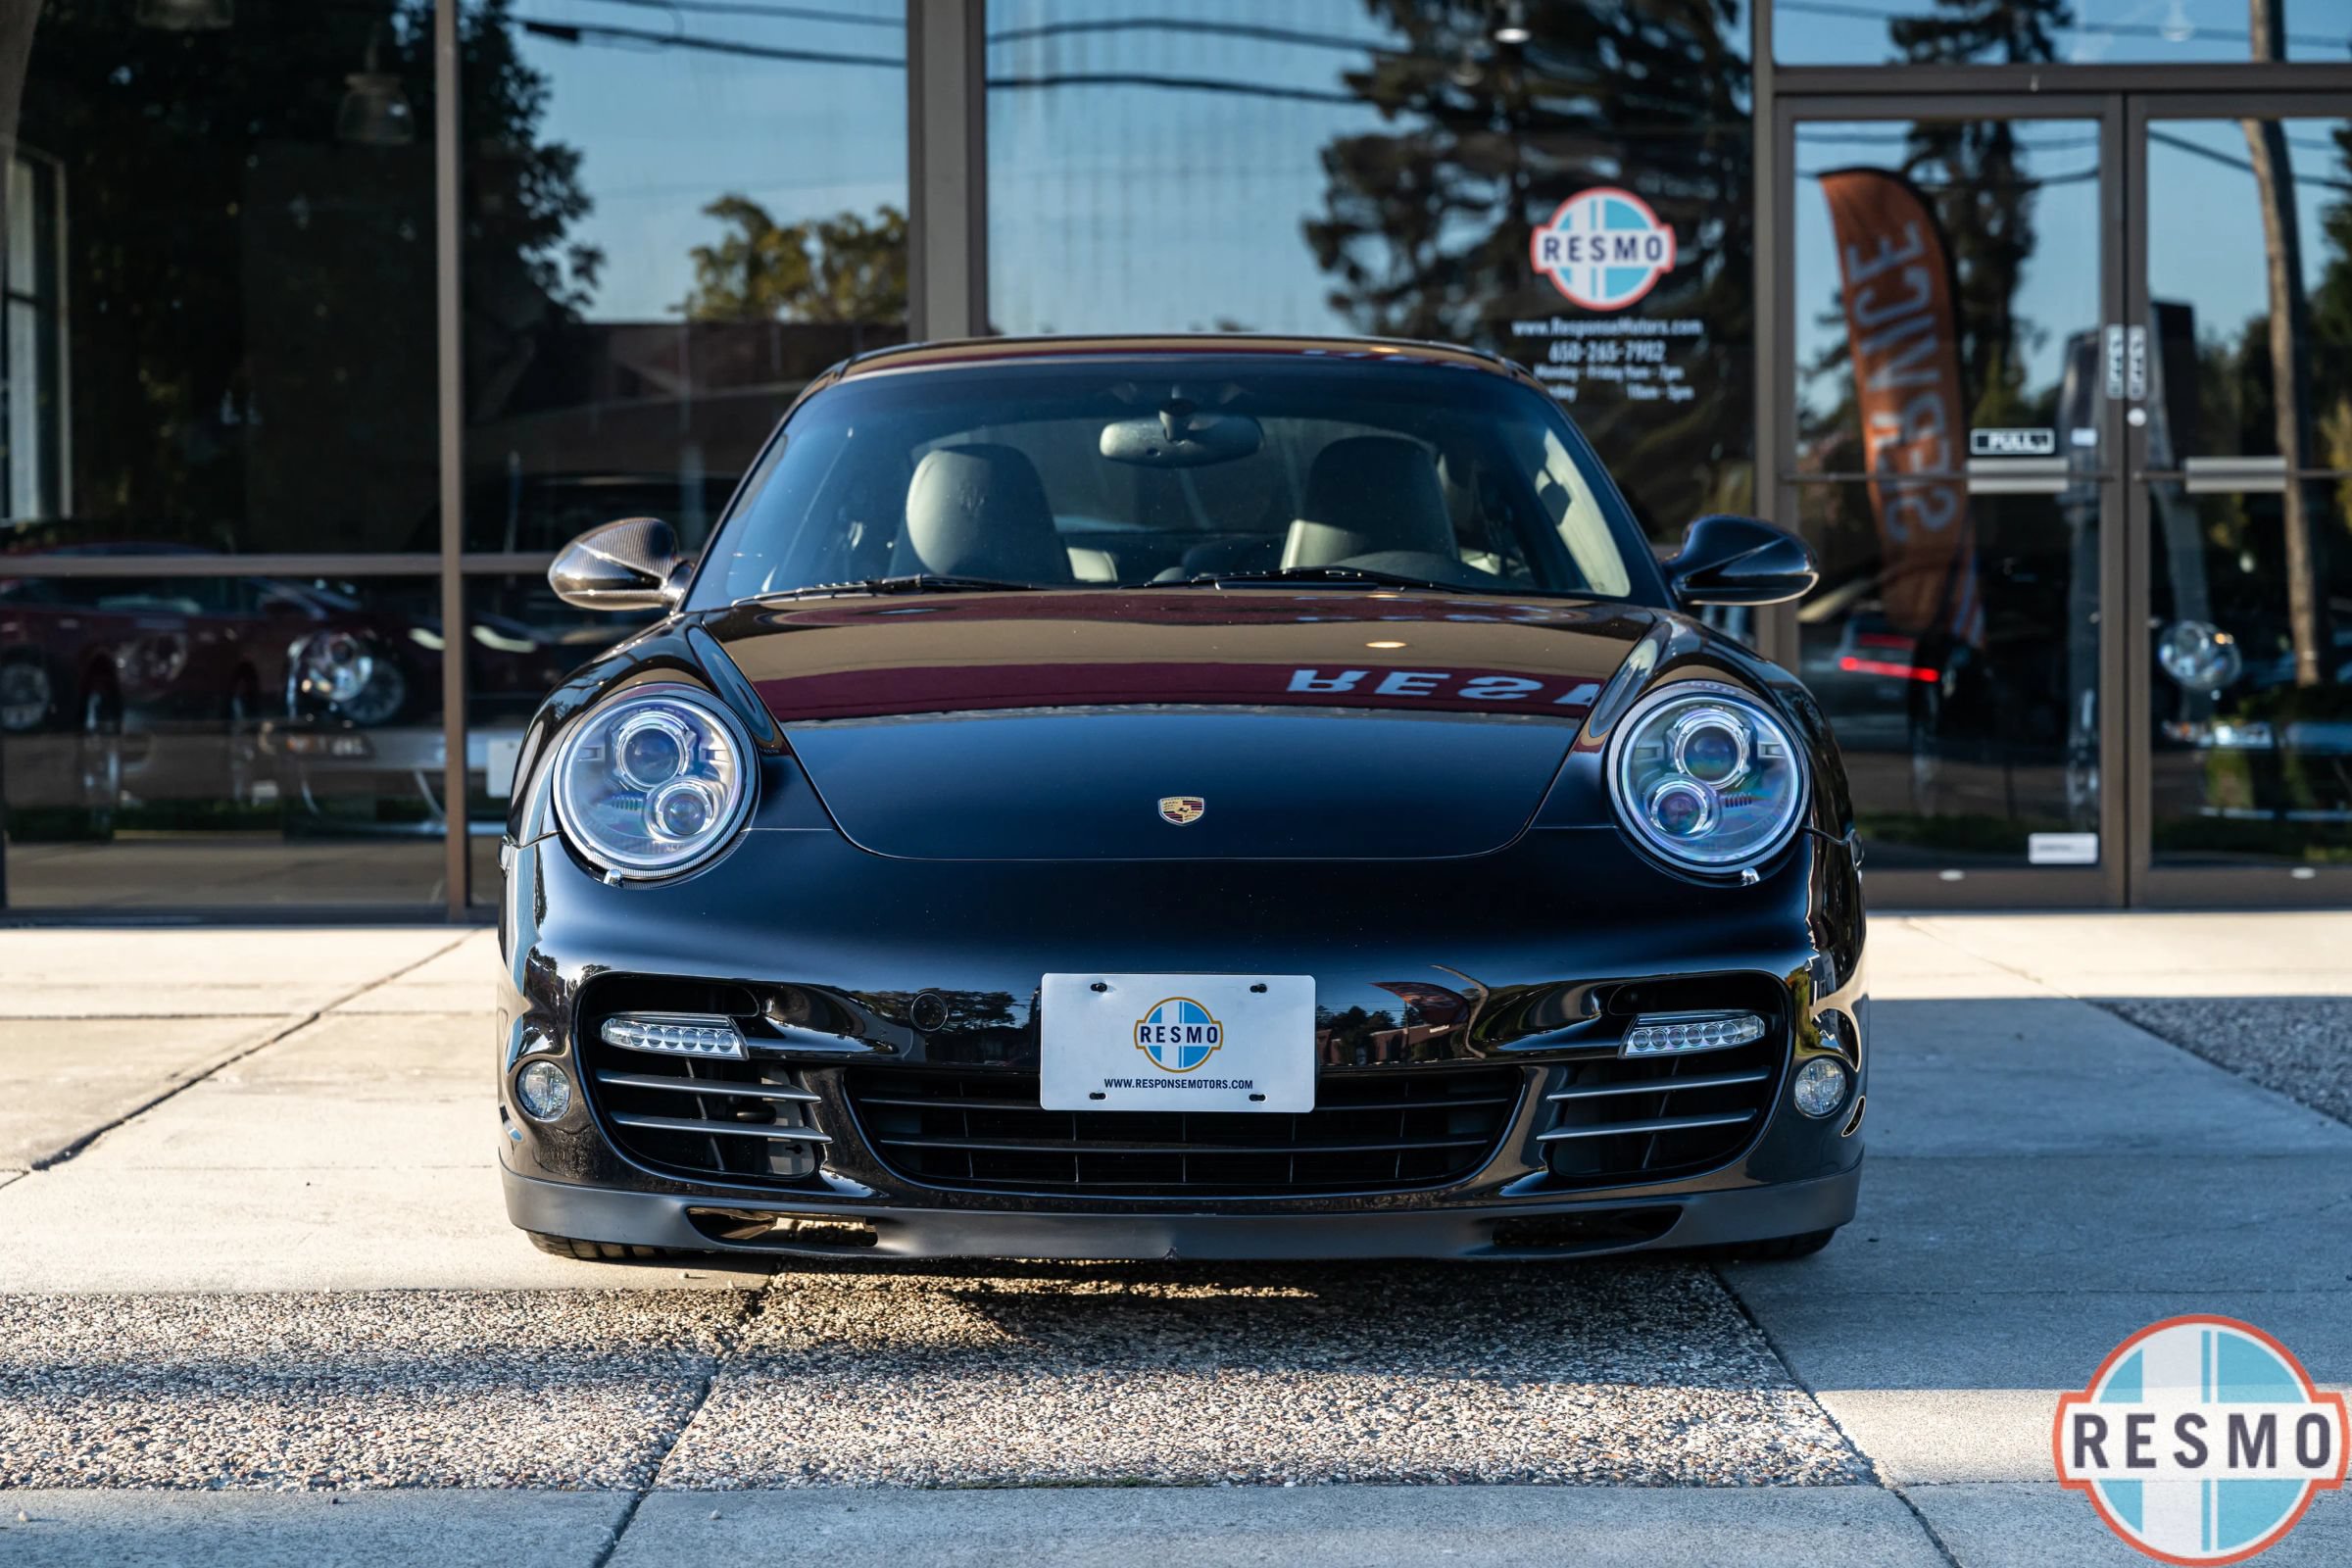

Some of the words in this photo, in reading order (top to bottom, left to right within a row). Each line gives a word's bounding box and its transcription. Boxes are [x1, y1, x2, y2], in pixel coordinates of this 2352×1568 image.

[1543, 234, 1664, 263] RESMO
[1988, 431, 2039, 452] PULL
[1140, 1025, 1218, 1044] RESMO
[1103, 1078, 1253, 1090] WWW.RESPONSEMOTORS.COM
